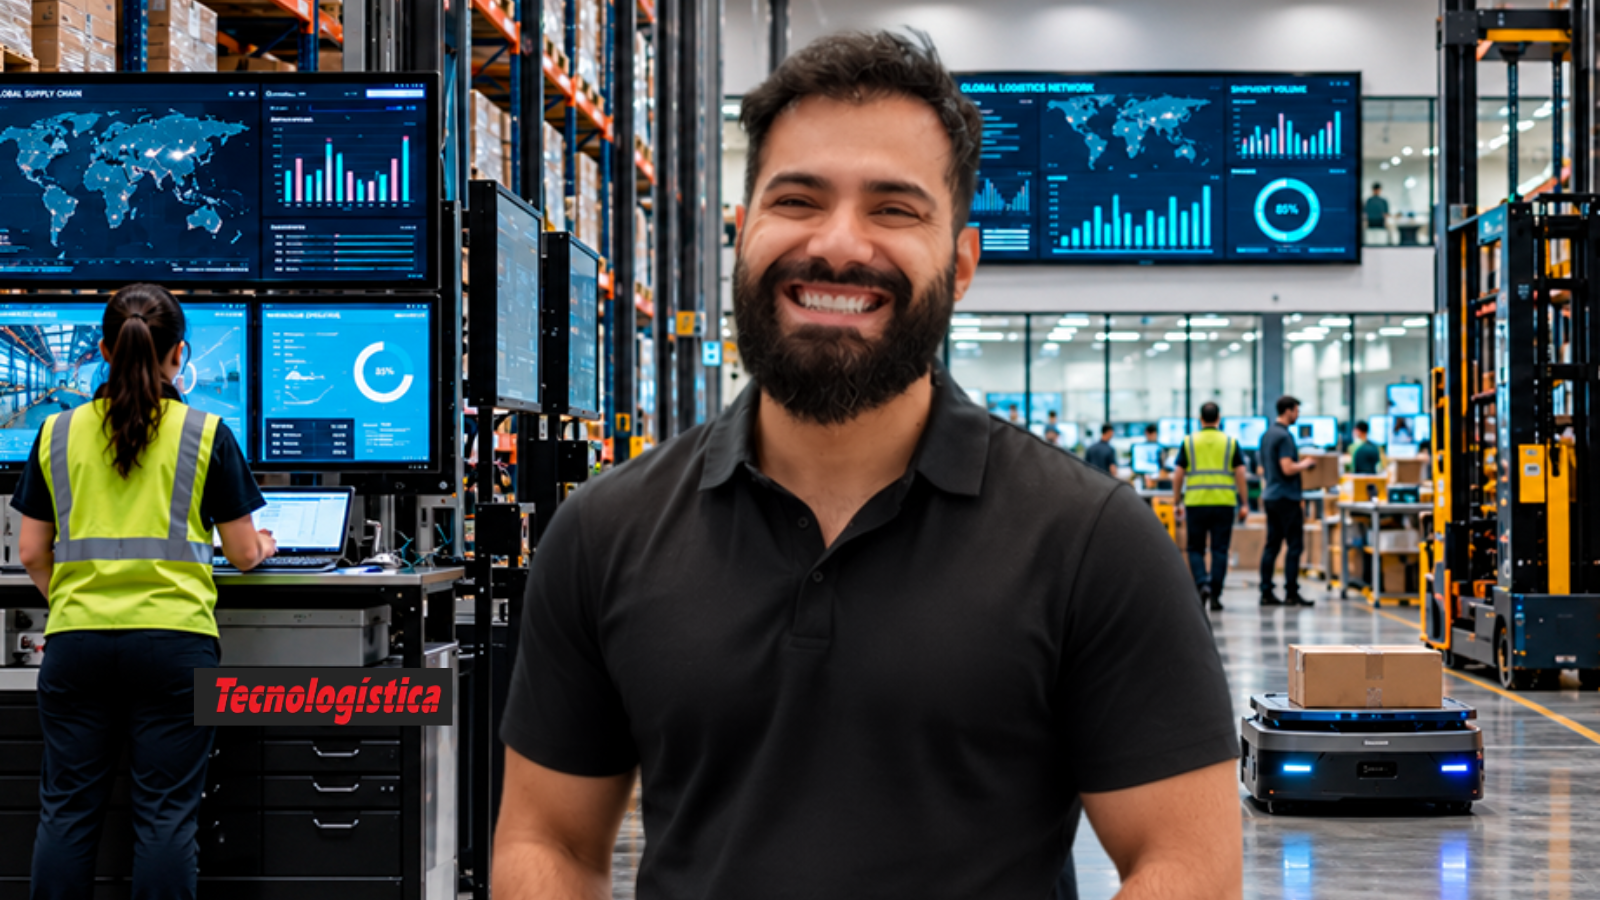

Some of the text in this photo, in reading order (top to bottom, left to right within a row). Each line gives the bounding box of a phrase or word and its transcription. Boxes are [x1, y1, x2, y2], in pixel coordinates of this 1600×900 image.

[960, 82, 1095, 92] GLOBAL LOGISTICS NETWORK
[0, 89, 22, 98] OBAL
[24, 89, 55, 98] SUPPLY
